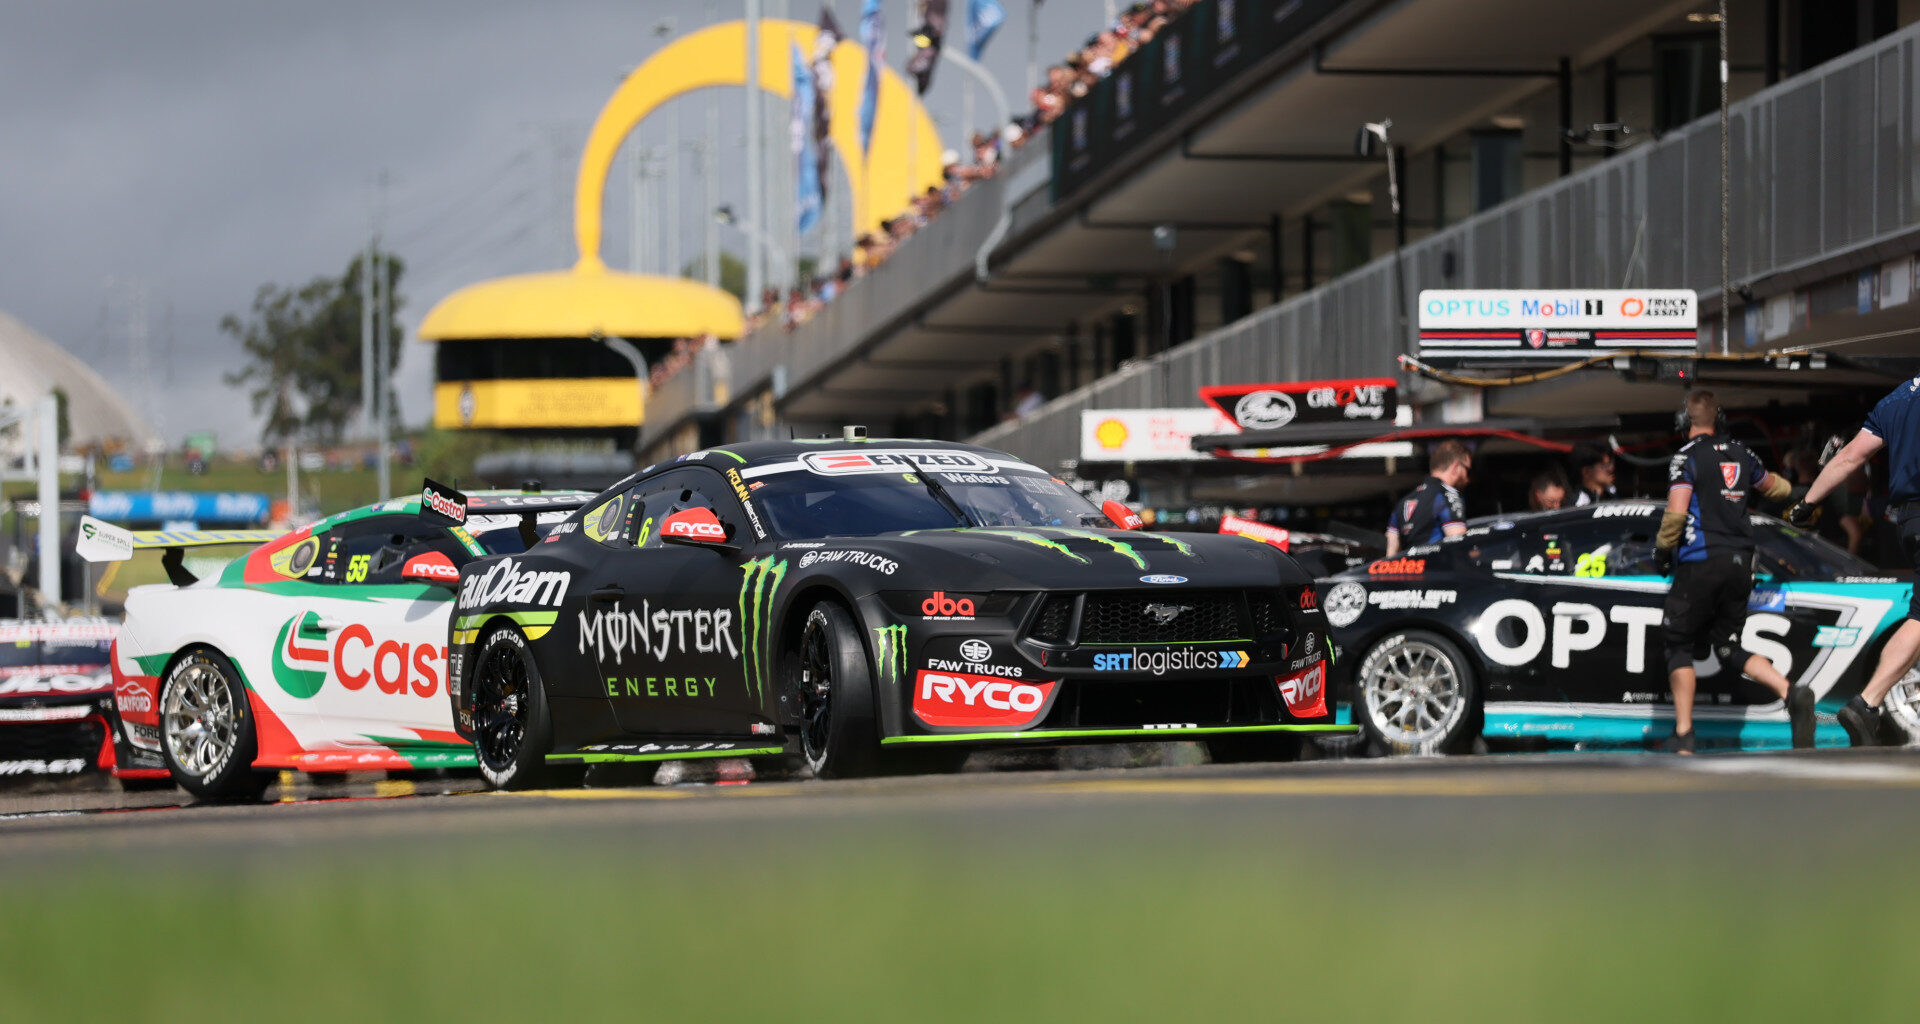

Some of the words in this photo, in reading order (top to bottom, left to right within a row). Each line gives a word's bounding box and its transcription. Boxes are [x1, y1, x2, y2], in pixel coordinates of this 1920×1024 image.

[1427, 299, 1510, 316] OPTUS
[1522, 299, 1580, 316] Mobil
[1306, 384, 1386, 409] GROVE
[902, 472, 919, 484] 6
[941, 471, 1011, 486] Waters
[432, 491, 466, 523] Castrol
[638, 517, 653, 548] 6
[670, 521, 724, 535] RYCO
[346, 555, 371, 583] 55
[412, 563, 460, 577] RYCO
[814, 550, 849, 564] FAW
[844, 550, 899, 576] TRUCKS
[1575, 552, 1607, 578] 25
[921, 591, 975, 616] dba
[489, 629, 525, 649] DUNLOP
[578, 598, 738, 666] MONSTER
[928, 658, 964, 673] FAW
[964, 662, 1023, 678] TRUCKS
[607, 677, 717, 697] ENERGY
[921, 673, 1044, 713] RYCO
[1278, 666, 1322, 708] RYCO
[117, 694, 152, 713] BAYFORD
[202, 733, 238, 786] DUNLOP
